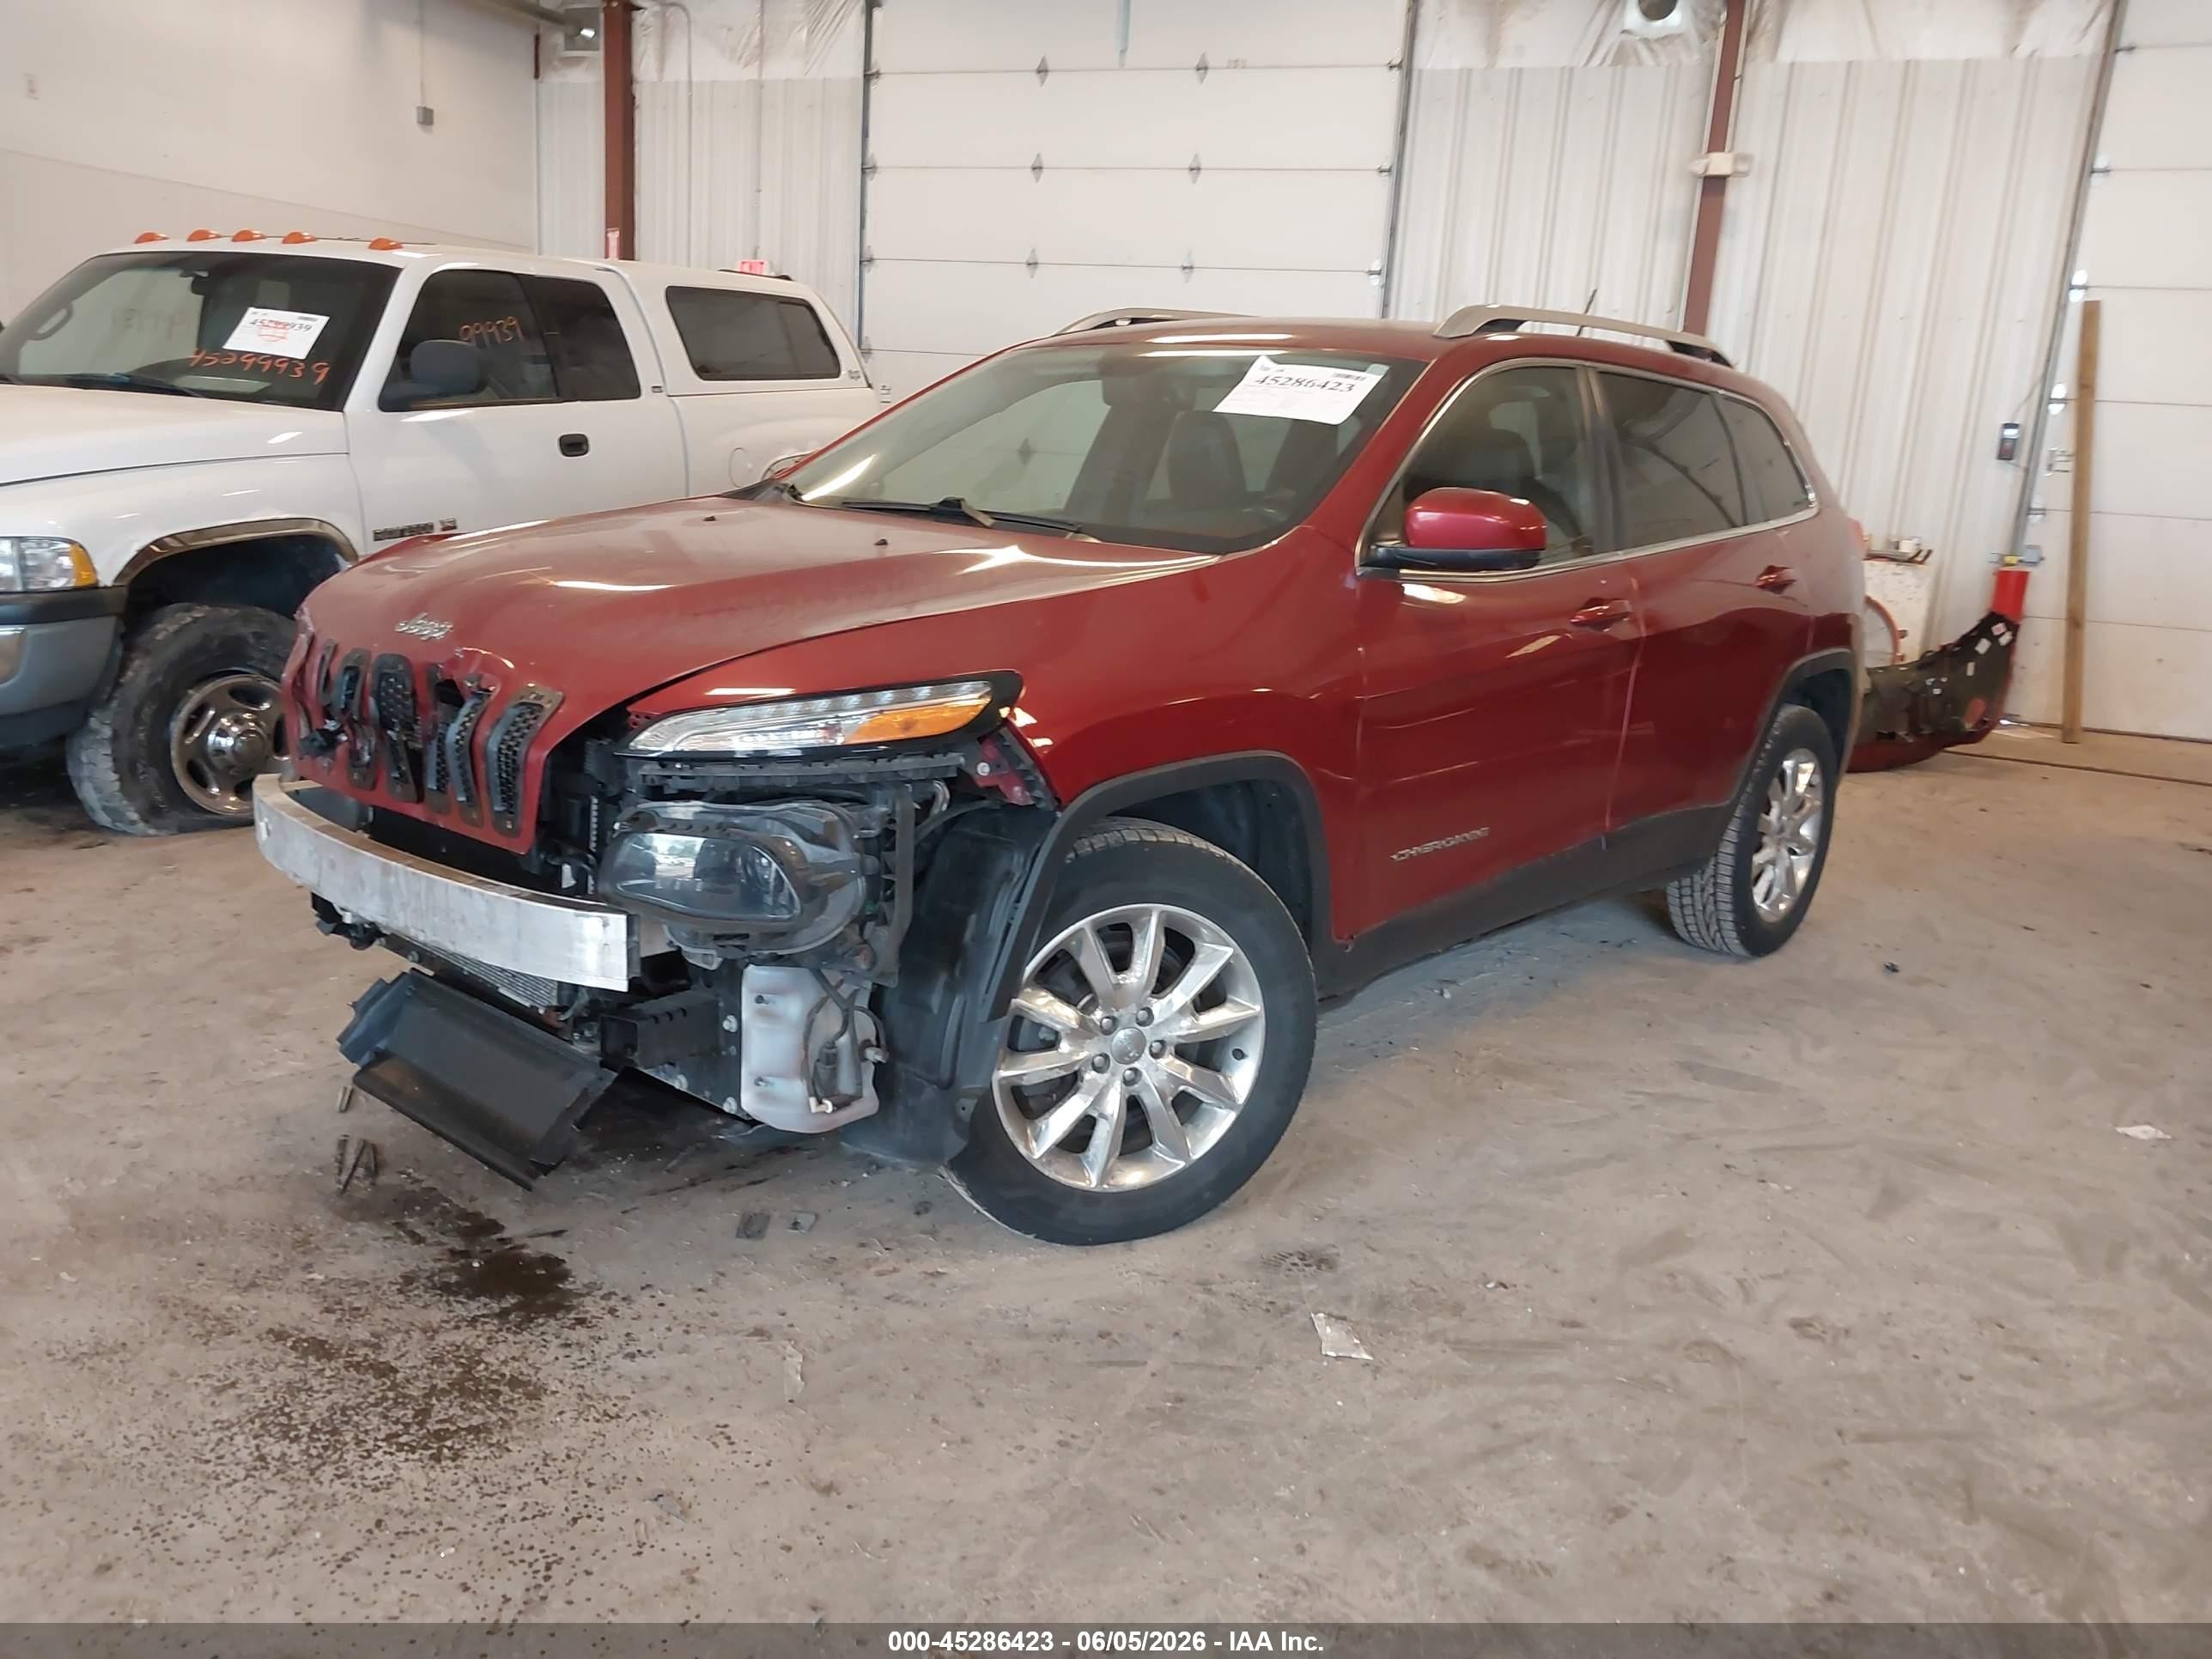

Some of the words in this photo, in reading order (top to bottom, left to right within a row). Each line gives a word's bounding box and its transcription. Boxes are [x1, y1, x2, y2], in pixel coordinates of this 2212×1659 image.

[1255, 375, 1356, 392] 45286423
[394, 612, 454, 641] Jeep
[1390, 827, 1491, 861] CHEROKEE
